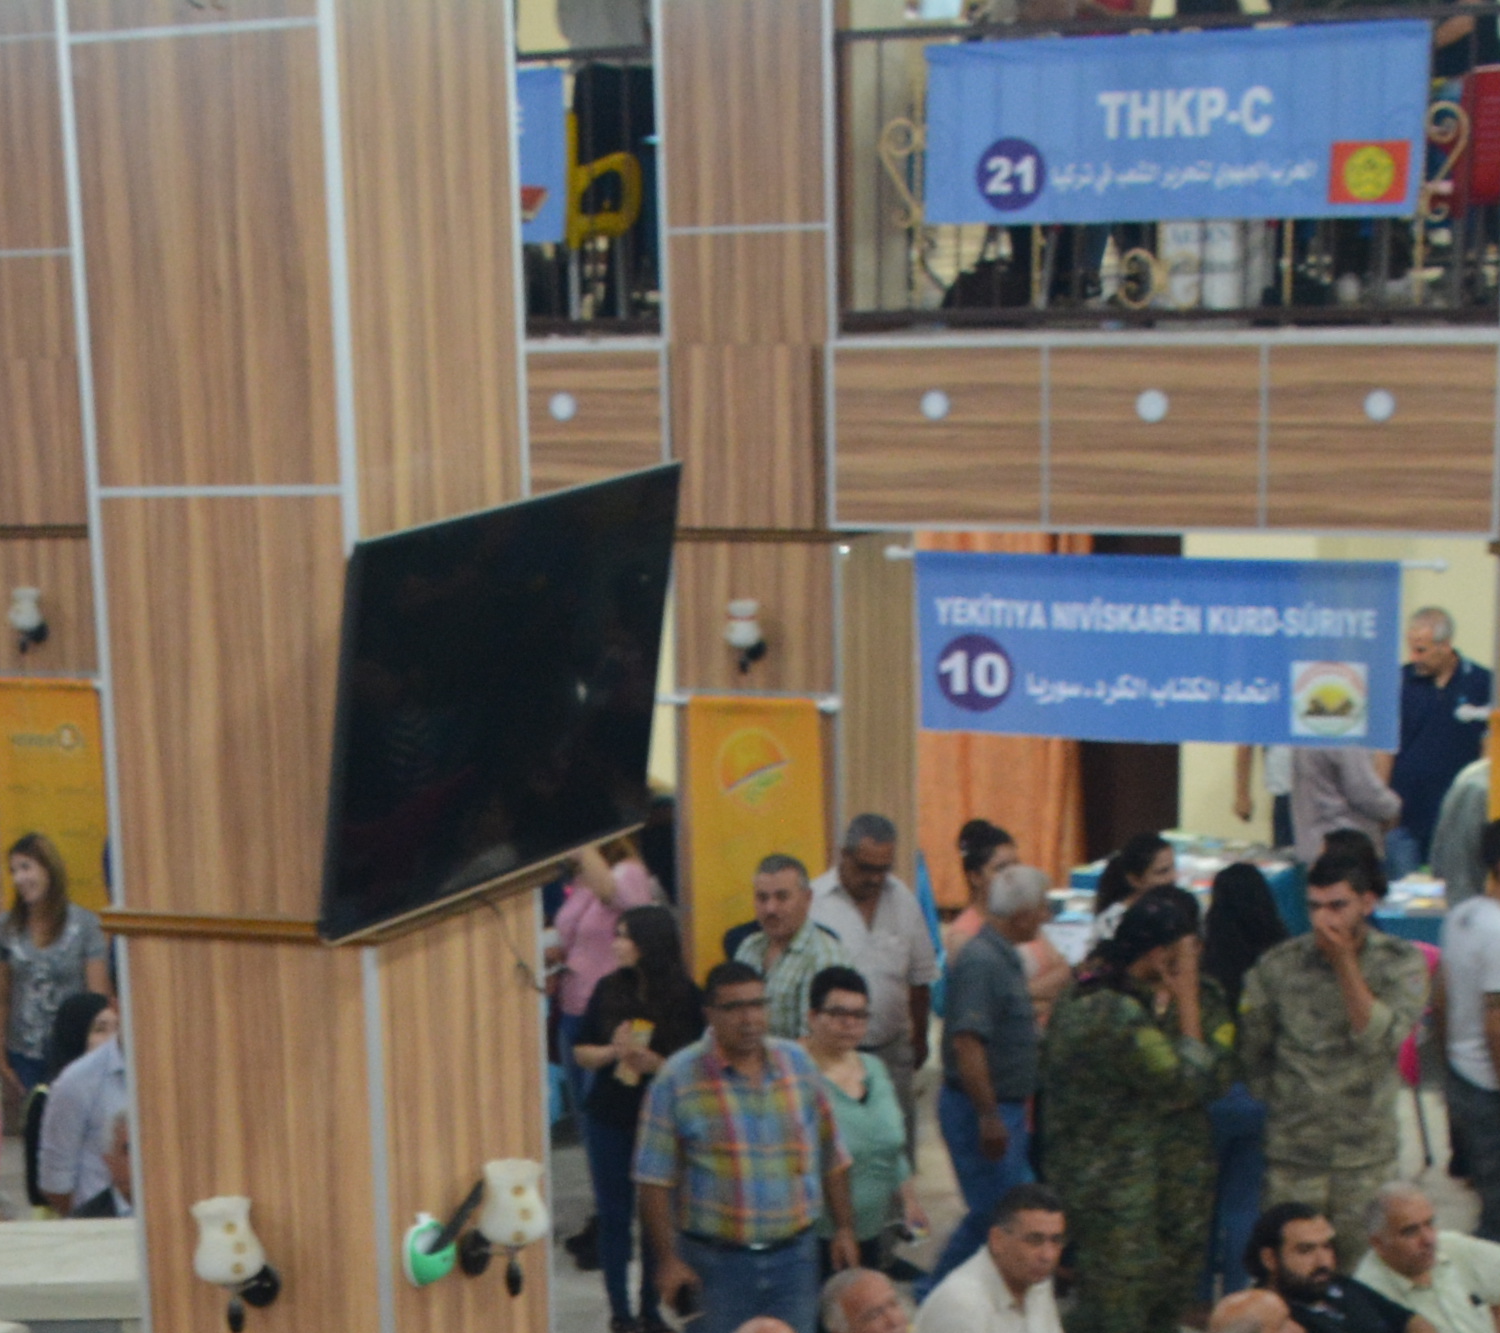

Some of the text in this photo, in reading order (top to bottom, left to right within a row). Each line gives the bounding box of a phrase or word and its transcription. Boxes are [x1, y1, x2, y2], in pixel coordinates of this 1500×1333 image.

[1099, 86, 1274, 137] THKP-C
[984, 156, 1036, 195] 21
[939, 651, 1010, 697] 10
